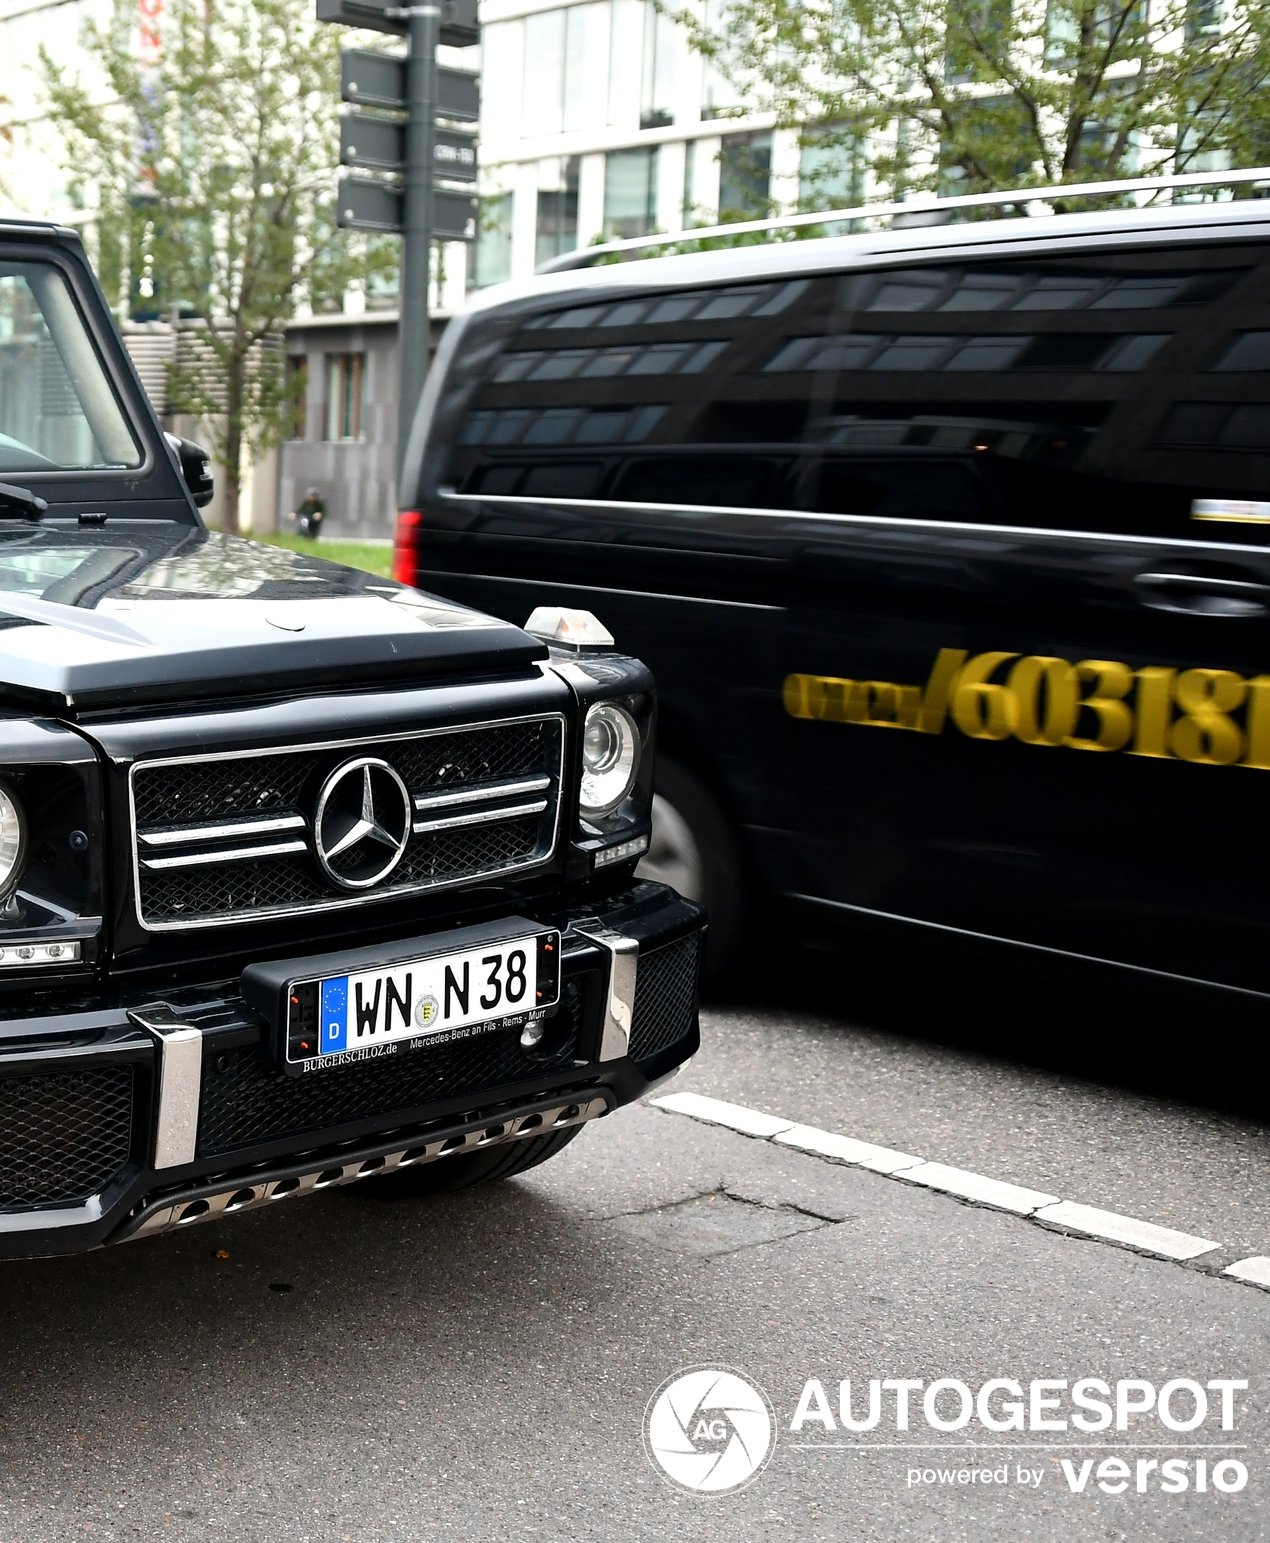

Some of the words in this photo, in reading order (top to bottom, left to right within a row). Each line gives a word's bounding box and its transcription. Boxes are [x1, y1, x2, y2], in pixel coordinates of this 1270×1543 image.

[328, 1022, 340, 1040] D
[354, 973, 412, 1037] WN
[444, 961, 470, 1019] N
[480, 950, 527, 1010] 38
[302, 1043, 398, 1073] BURGERSCHLOZ.de
[410, 1028, 470, 1049] Mercedes-Benz
[471, 1026, 482, 1036] an
[483, 1021, 496, 1033] Fils
[502, 1015, 523, 1028] Rems
[528, 1009, 546, 1021] Murr
